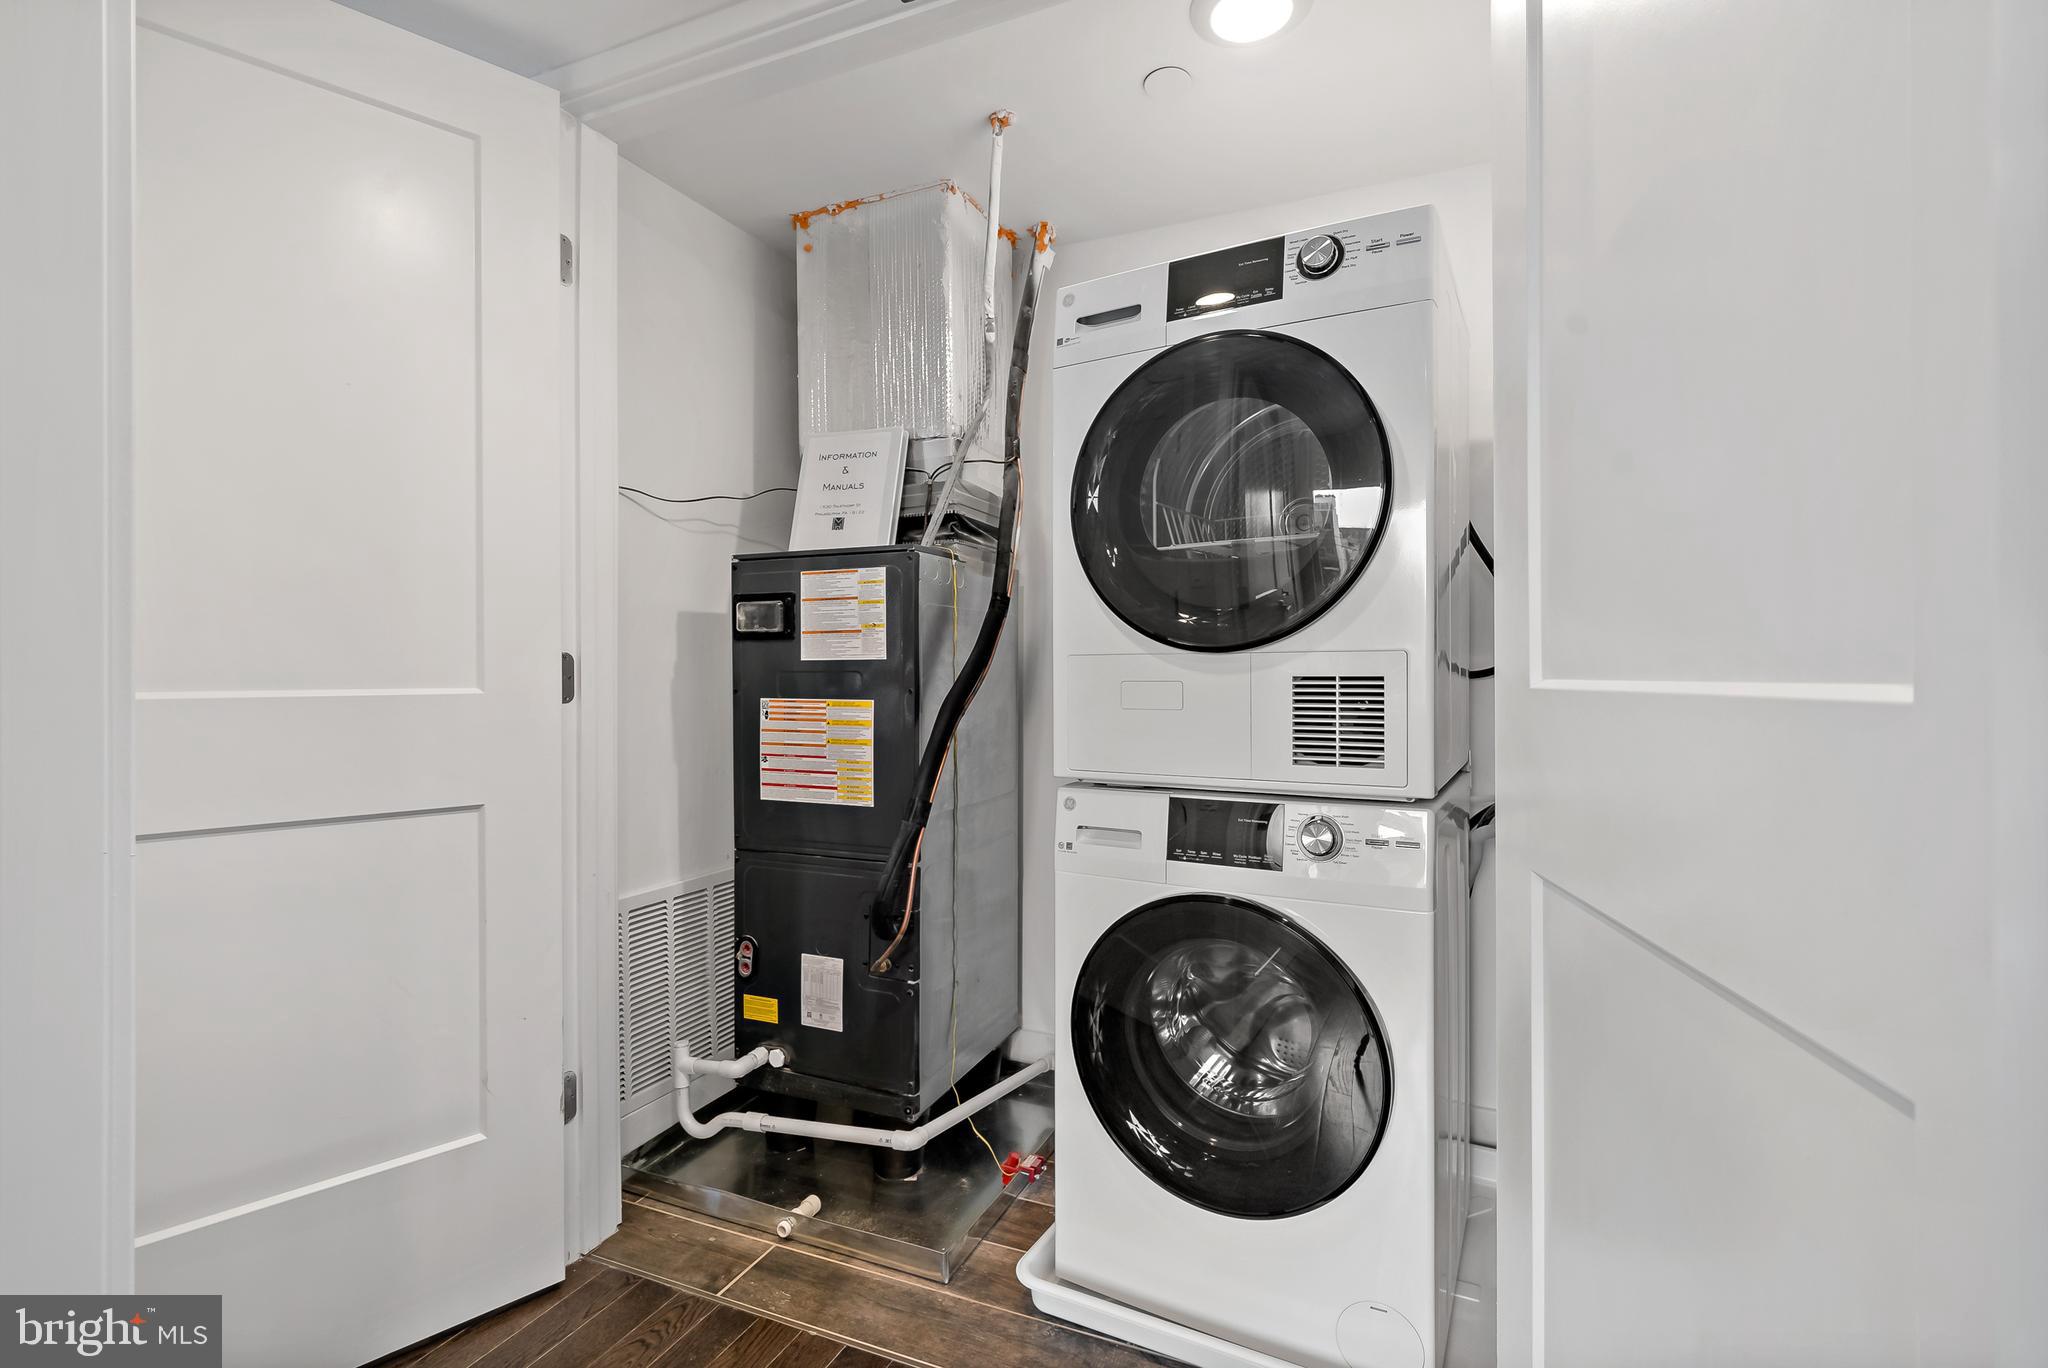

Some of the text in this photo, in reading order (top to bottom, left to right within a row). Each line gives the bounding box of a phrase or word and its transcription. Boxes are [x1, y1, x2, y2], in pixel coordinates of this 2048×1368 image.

[818, 451, 878, 461] INFORMATION
[842, 466, 849, 475] &
[822, 483, 865, 492] MANUALS
